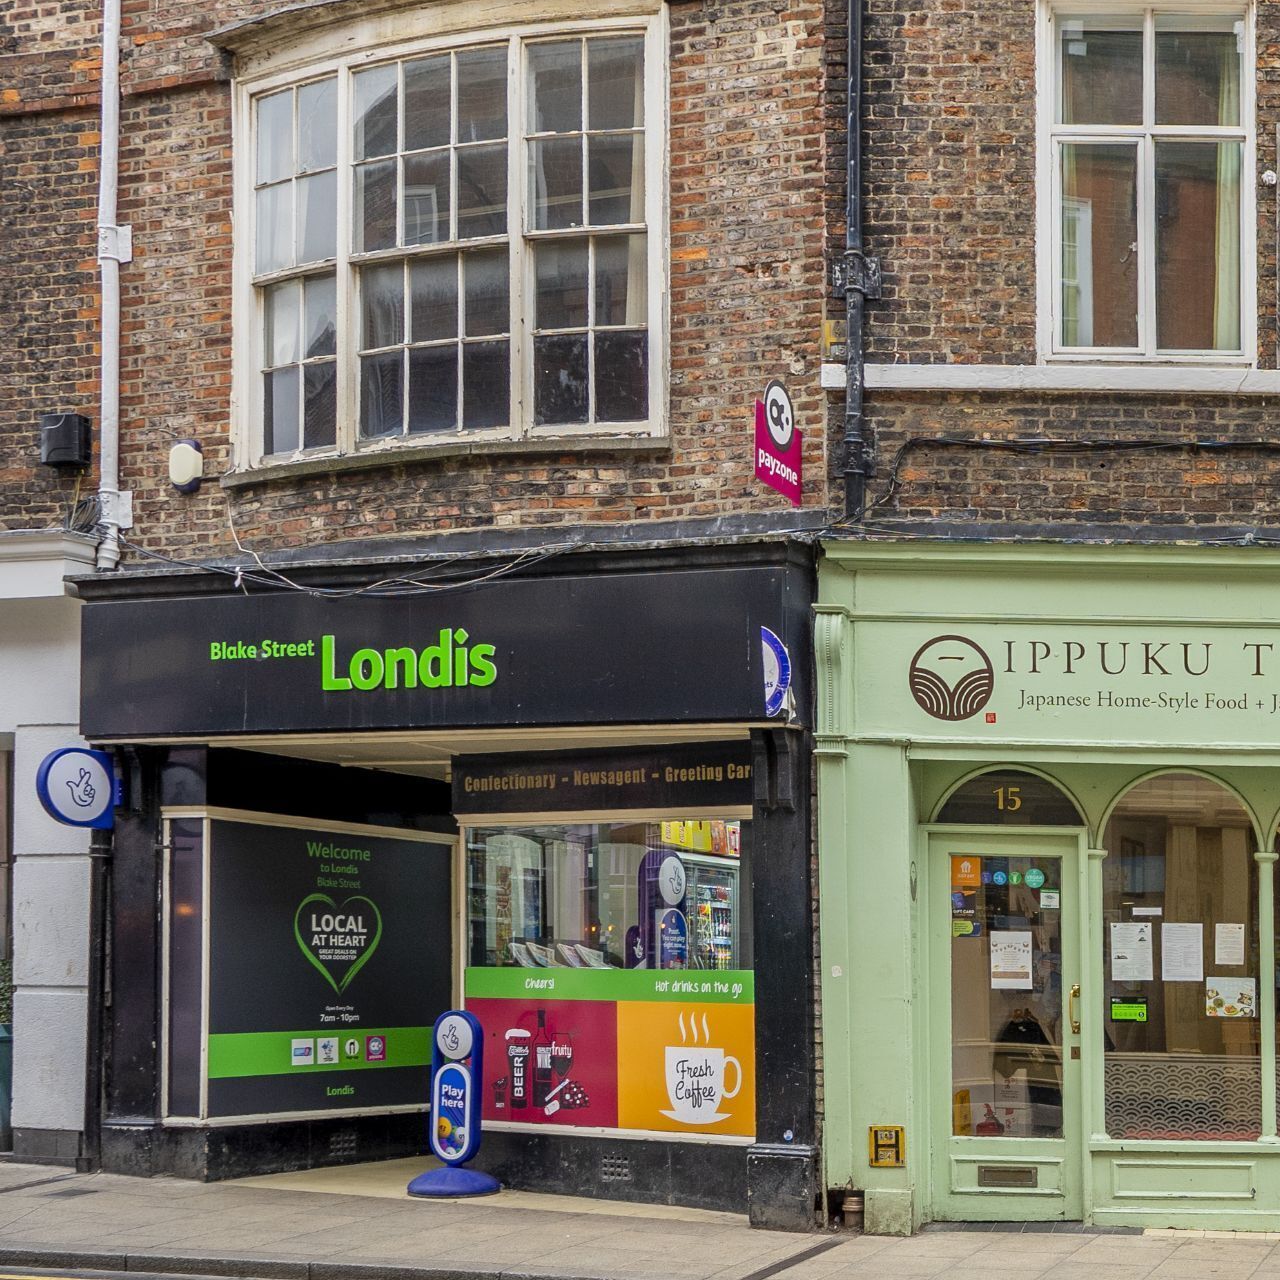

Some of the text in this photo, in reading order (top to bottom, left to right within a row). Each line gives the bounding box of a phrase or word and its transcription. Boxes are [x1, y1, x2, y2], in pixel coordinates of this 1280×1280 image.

[758, 448, 798, 486] payzone
[210, 639, 315, 661] Blake Street
[322, 628, 498, 691] Londis
[1003, 640, 1213, 677] IPPUKU
[1018, 689, 1091, 712] Japanese
[1097, 690, 1199, 713] Home-Style
[1204, 692, 1248, 710] Food
[465, 772, 557, 792] Confectionary
[574, 768, 646, 786] Newsagent
[665, 764, 723, 783] Greeting
[727, 763, 753, 779] Car
[992, 787, 1022, 811] 15
[306, 841, 371, 861] Welcome
[320, 864, 359, 874] to Londis
[317, 877, 361, 889] Blake Street
[311, 914, 367, 933] LOCAL
[312, 935, 366, 947] AT HEART
[525, 977, 555, 990] Cheers!
[655, 981, 743, 999] Hot drinks on the go
[320, 1014, 336, 1022] 7am
[340, 1013, 360, 1023] 10pm
[552, 1041, 572, 1059] fruity
[513, 1057, 524, 1097] BEER
[675, 1059, 714, 1078] Fresh
[327, 1085, 355, 1096] Londis
[441, 1084, 464, 1100] Play
[675, 1080, 716, 1108] Coffee
[441, 1096, 464, 1109] here
